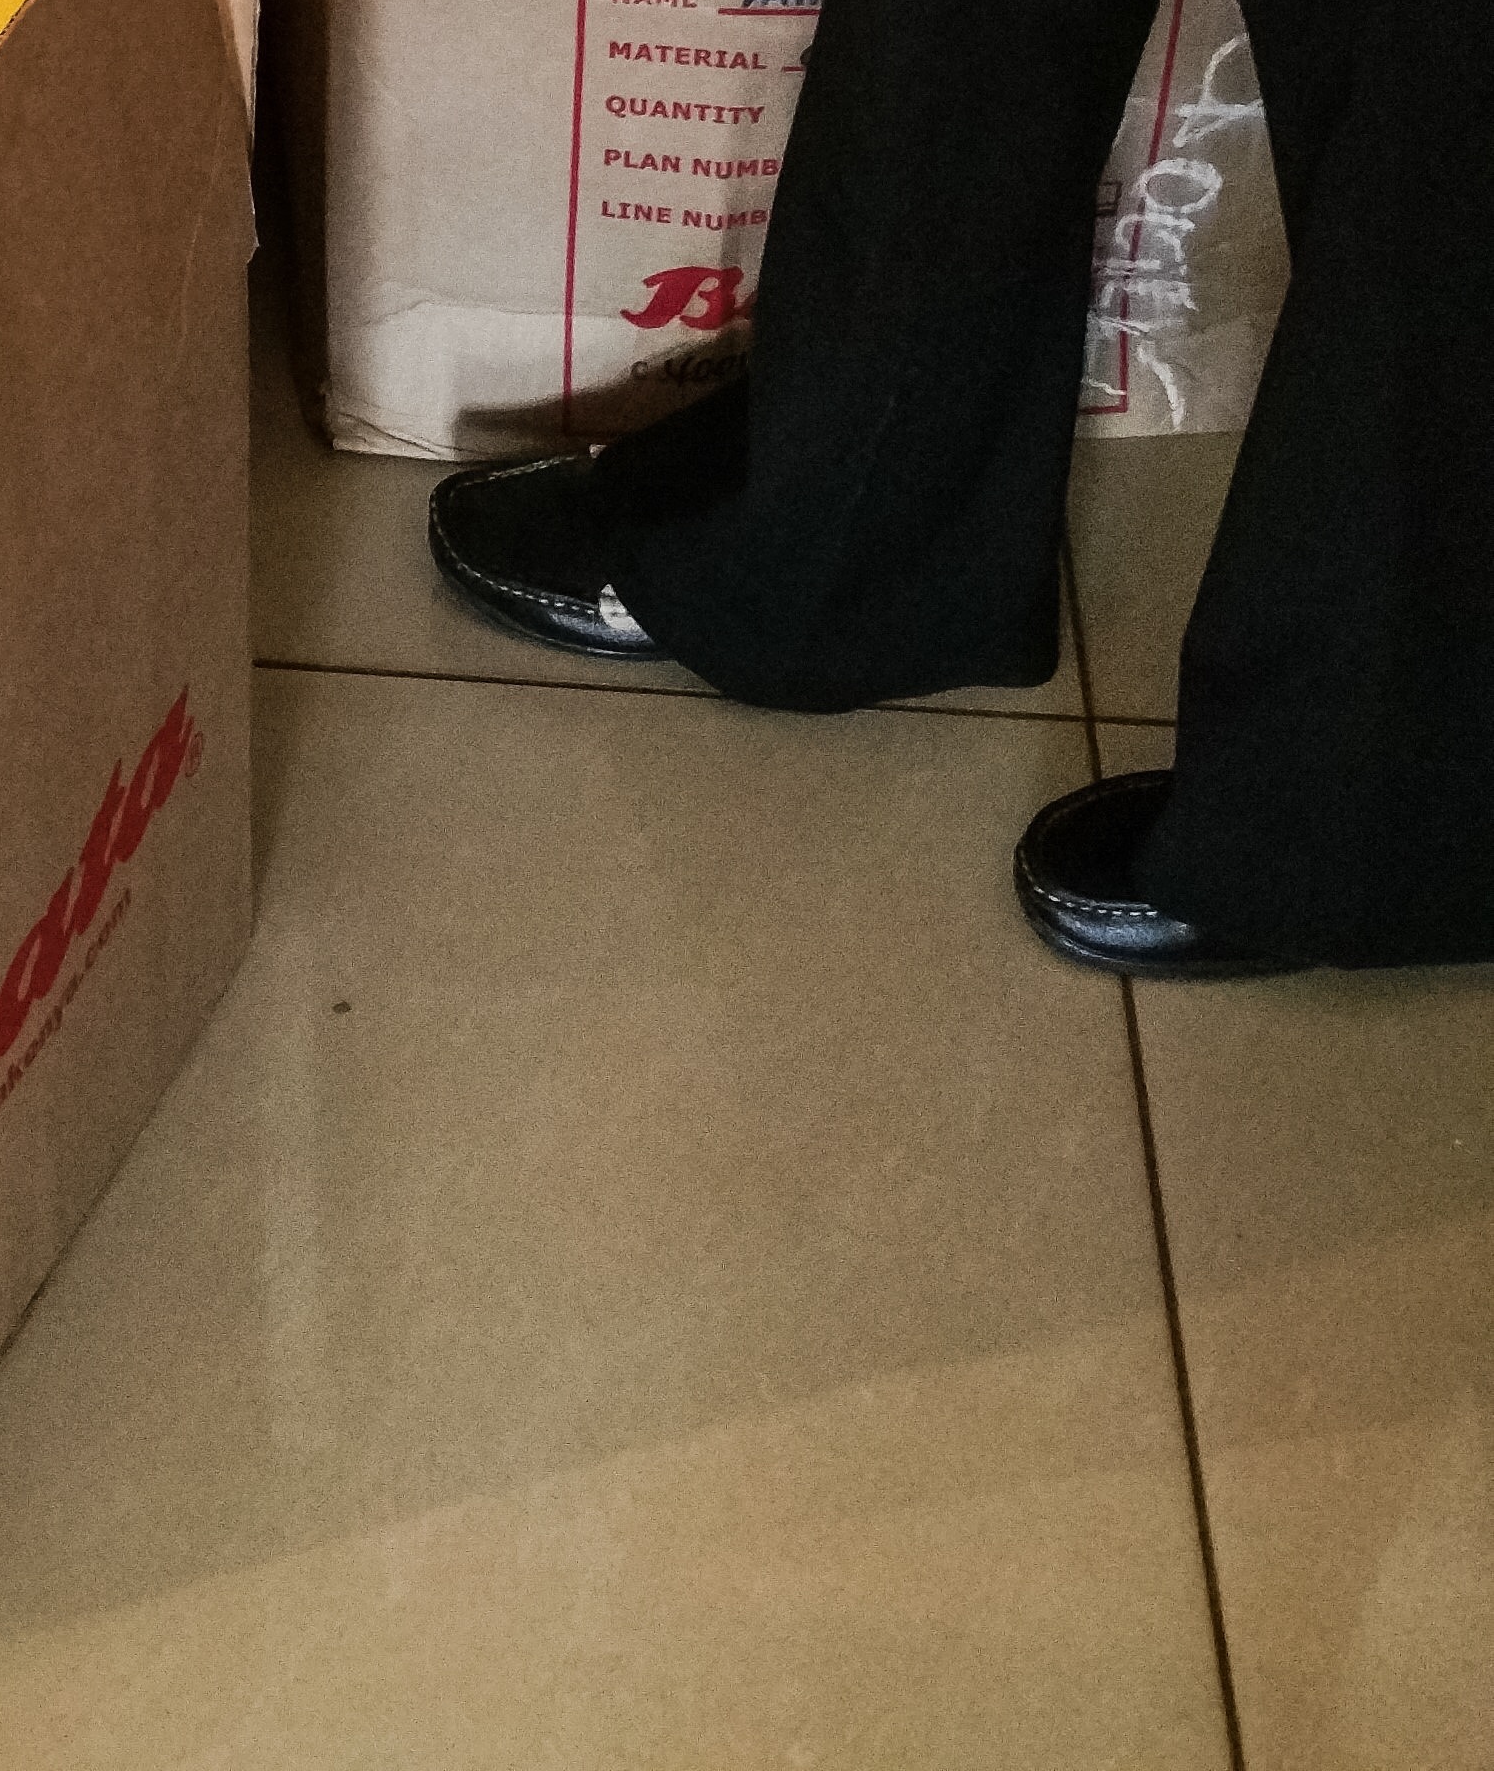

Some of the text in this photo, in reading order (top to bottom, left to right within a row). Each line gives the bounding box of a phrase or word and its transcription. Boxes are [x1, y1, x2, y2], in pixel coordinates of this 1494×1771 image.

[608, 41, 768, 70] MATERIAL
[605, 94, 766, 125] QUANTITY
[603, 149, 681, 173] PLAN
[601, 201, 672, 225] LINE
[620, 266, 756, 330] B
